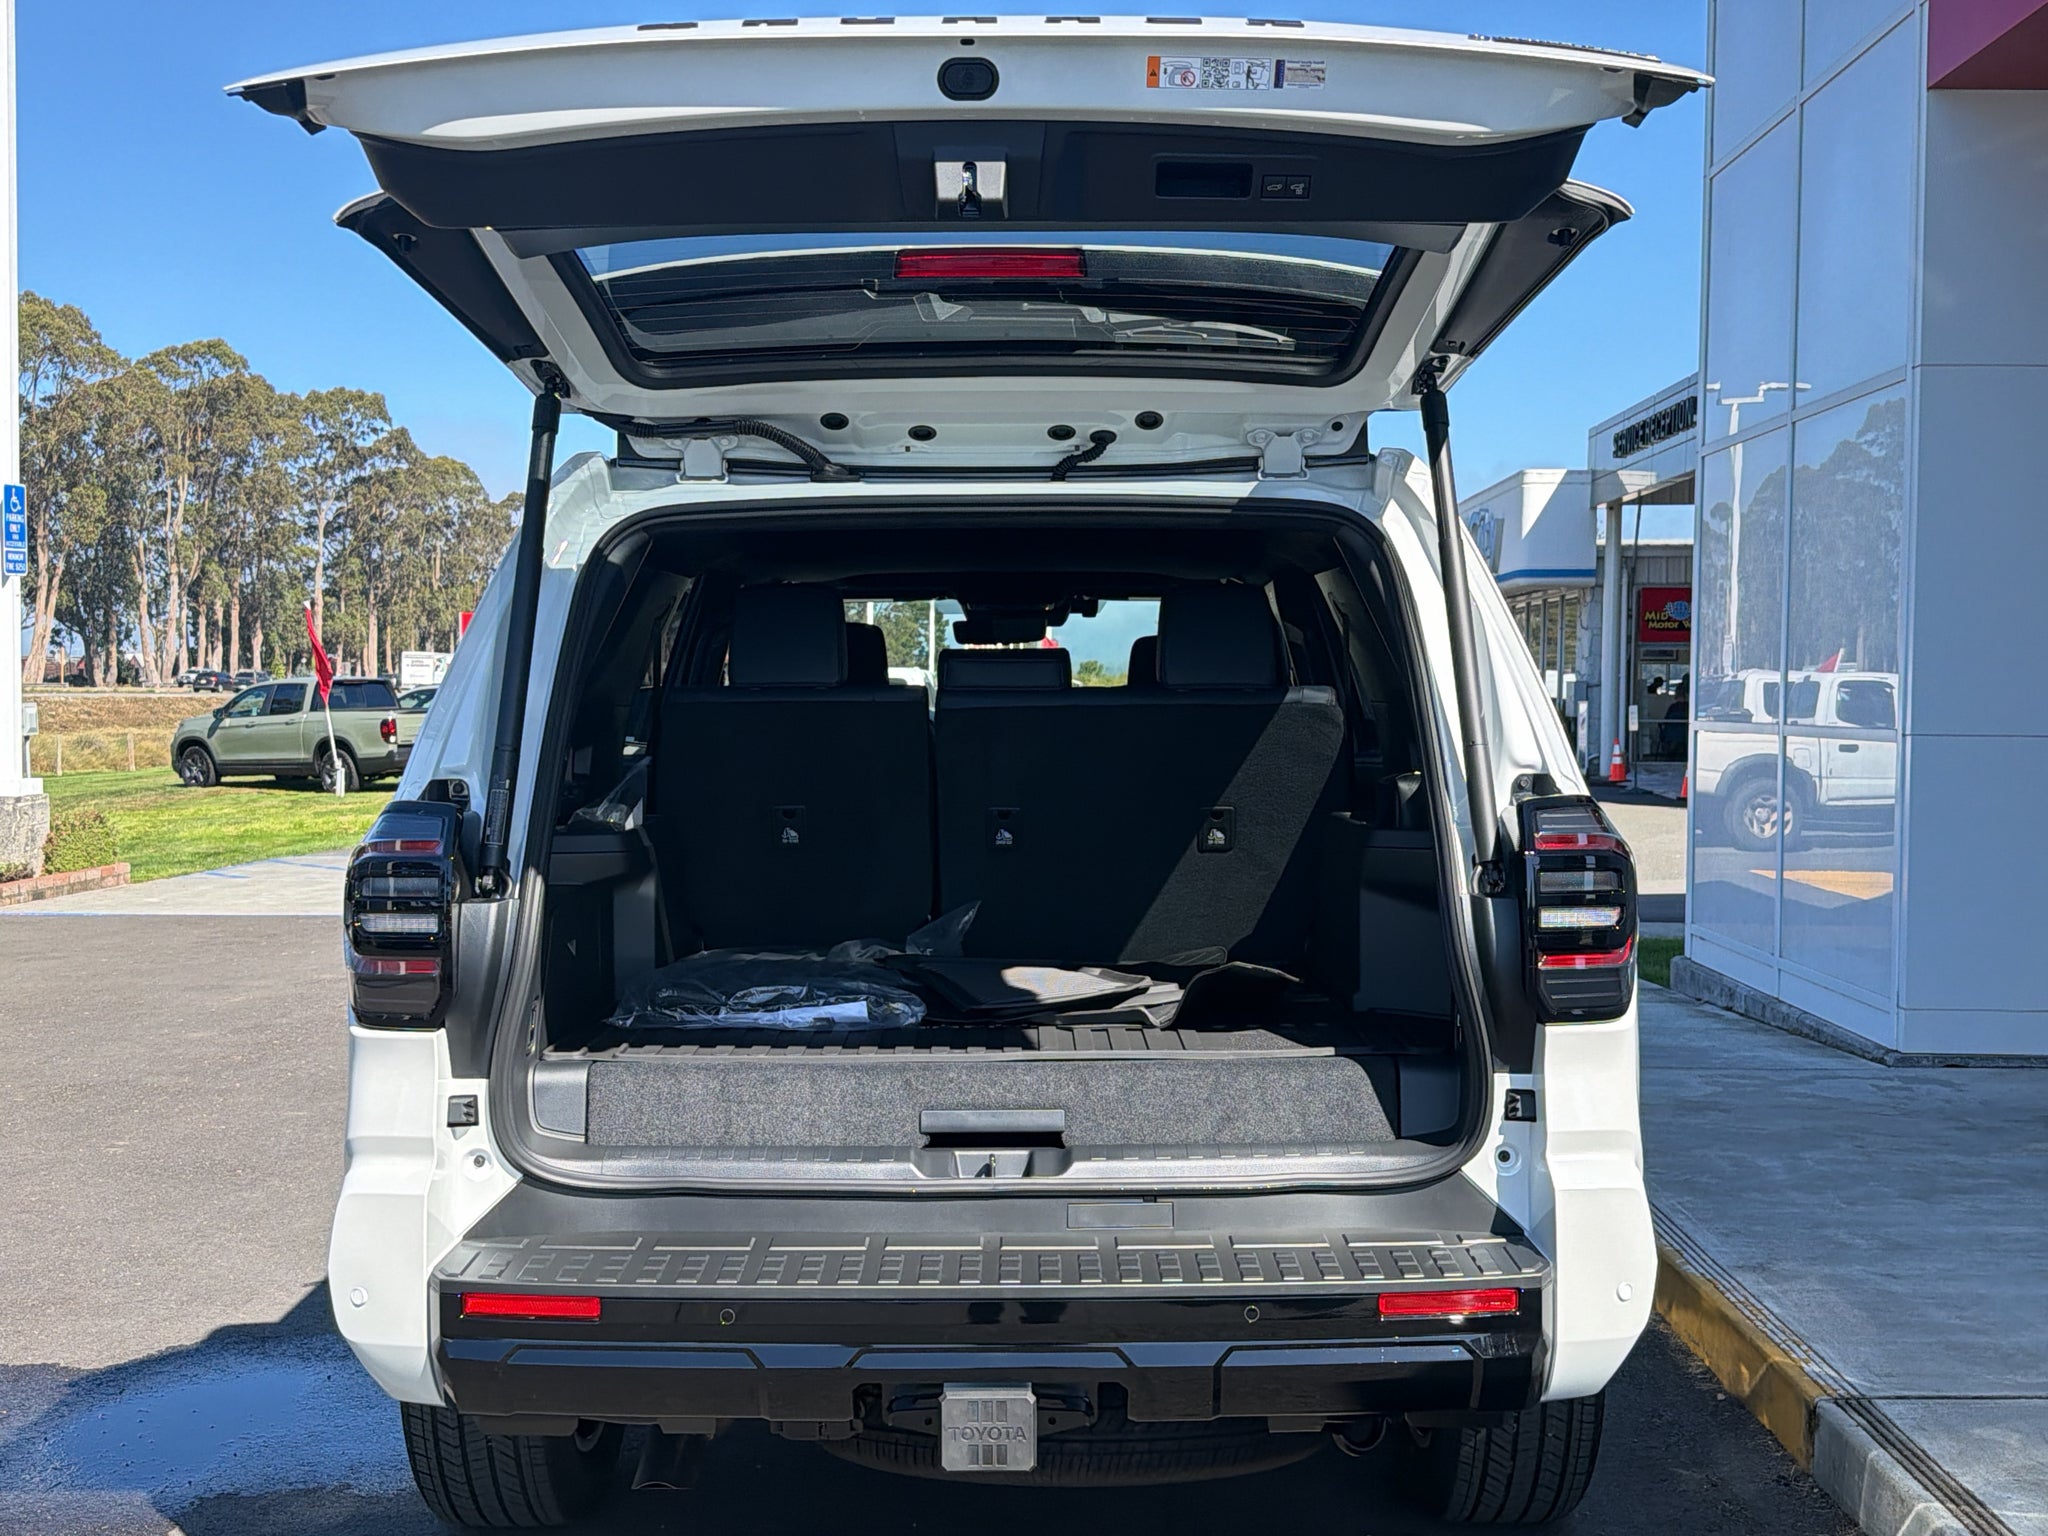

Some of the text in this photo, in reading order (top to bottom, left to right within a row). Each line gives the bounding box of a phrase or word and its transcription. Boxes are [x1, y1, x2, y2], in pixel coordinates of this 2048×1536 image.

[1613, 420, 1644, 458] SERVICE
[1648, 620, 1679, 629] Motor
[947, 1426, 1027, 1442] TOYOTA
